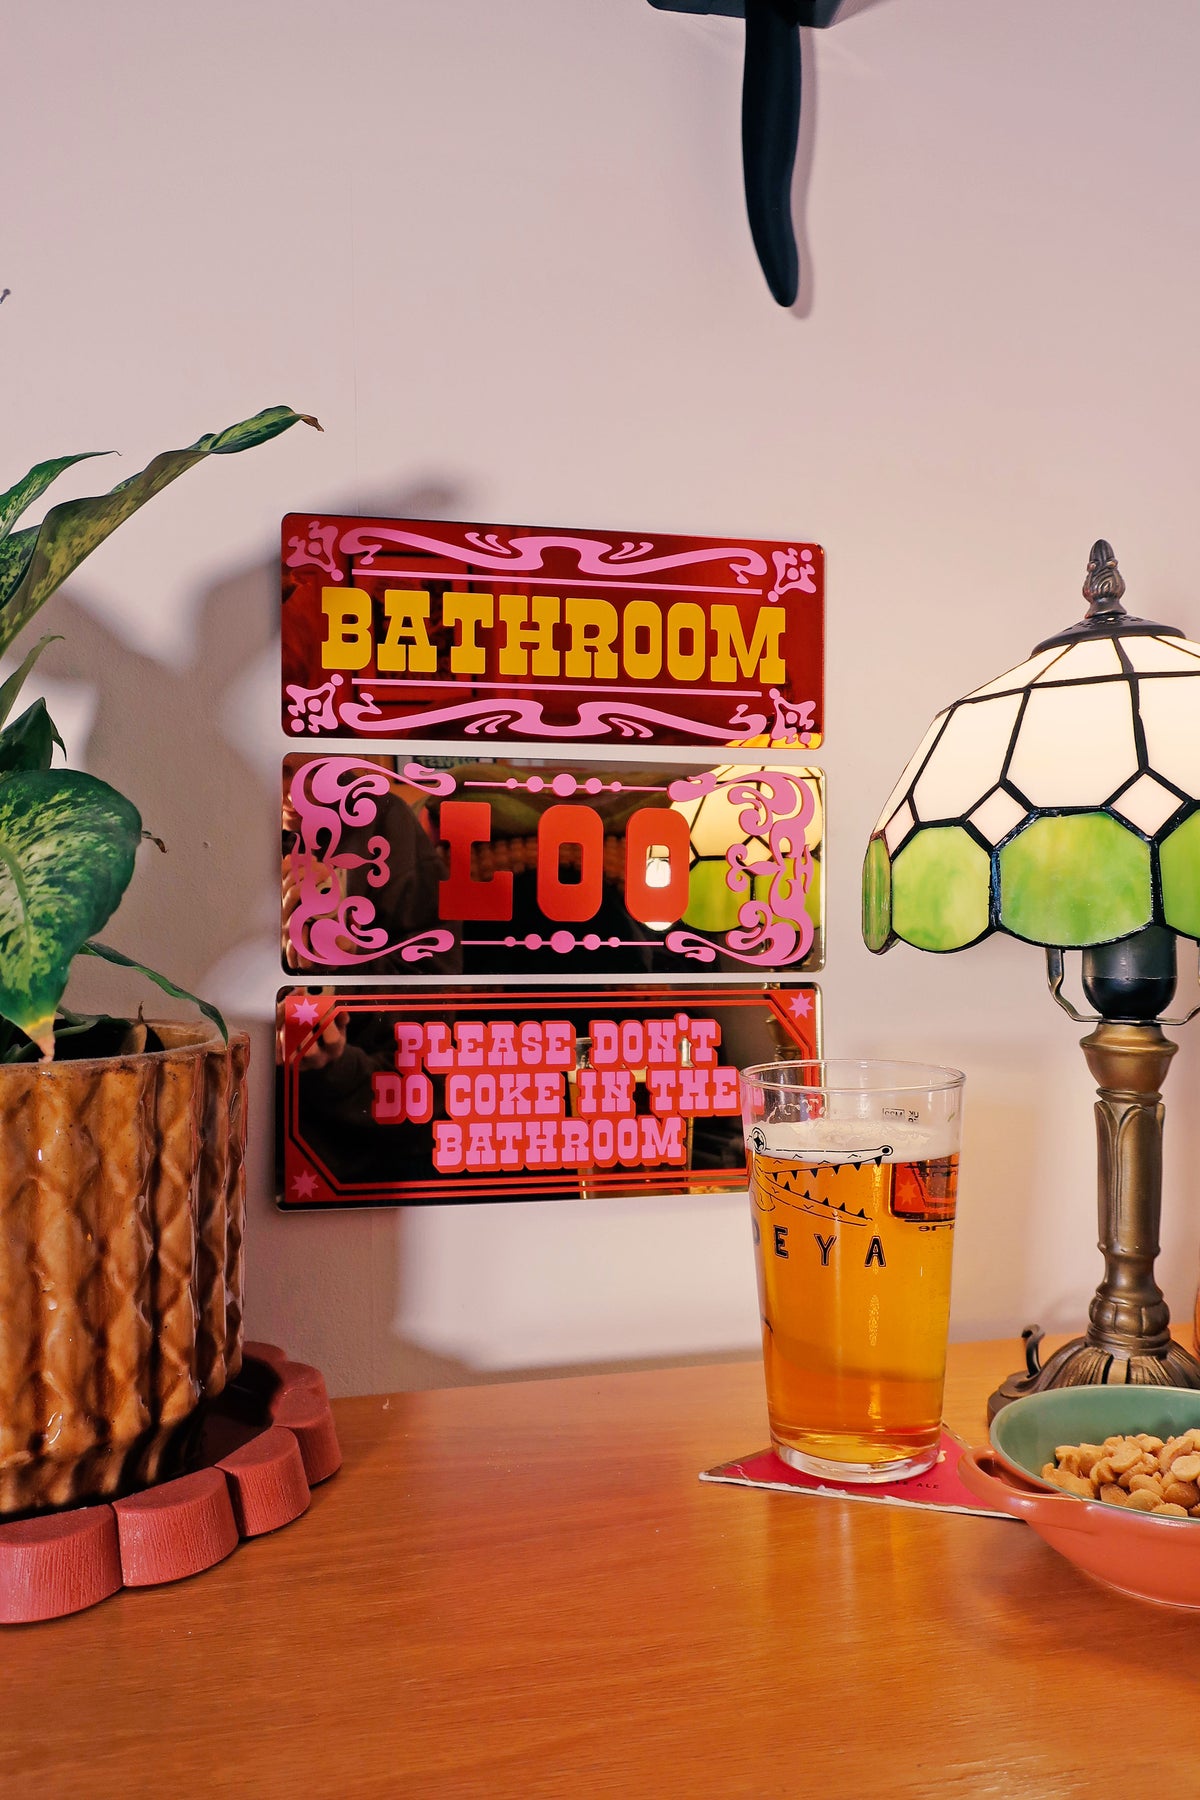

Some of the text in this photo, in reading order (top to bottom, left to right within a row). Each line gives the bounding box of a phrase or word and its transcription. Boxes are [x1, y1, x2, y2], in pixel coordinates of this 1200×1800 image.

[320, 586, 787, 685] BATHROOM
[438, 800, 691, 923] LOO
[395, 1013, 719, 1068] PLEASE DON'T
[373, 1068, 739, 1120] DO COKE IN THE
[435, 1116, 683, 1167] BATHROOM
